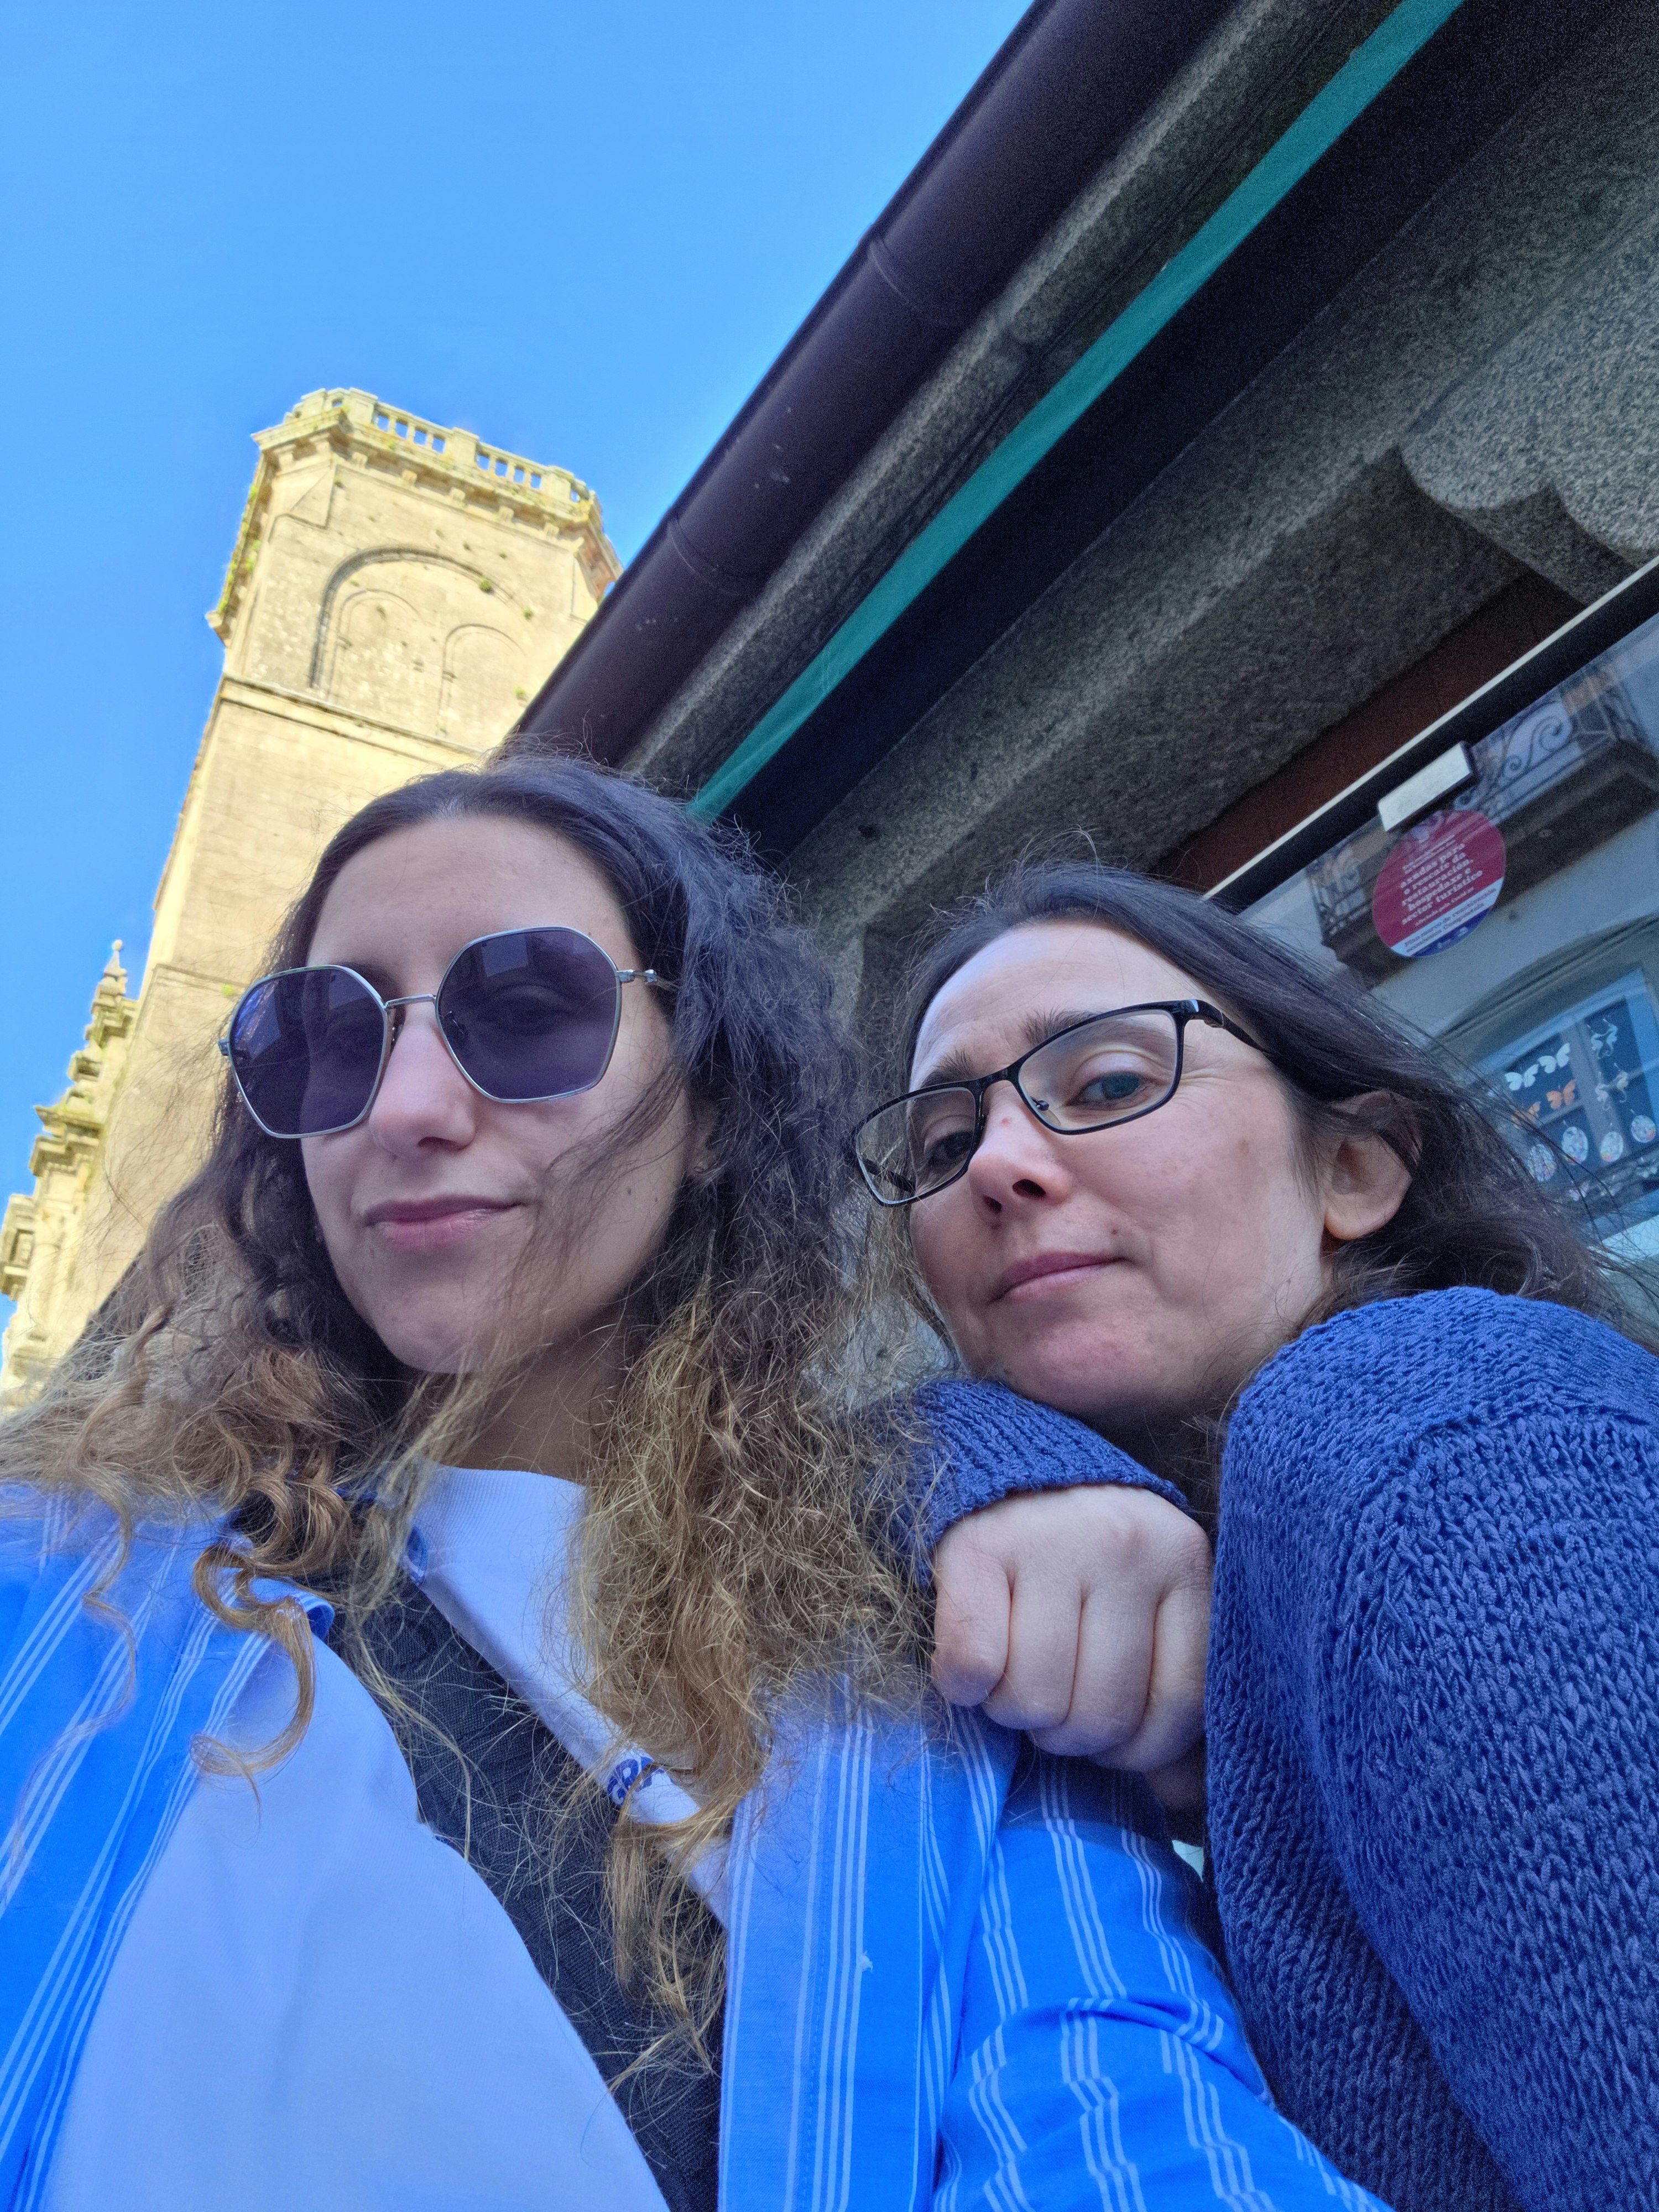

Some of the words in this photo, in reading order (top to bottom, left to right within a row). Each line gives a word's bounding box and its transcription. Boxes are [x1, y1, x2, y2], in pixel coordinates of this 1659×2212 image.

[1440, 843, 1464, 863] para
[1412, 863, 1449, 890] rescate
[1452, 853, 1466, 863] da
[1408, 874, 1462, 911] hospedaxe
[1402, 901, 1433, 925] sector
